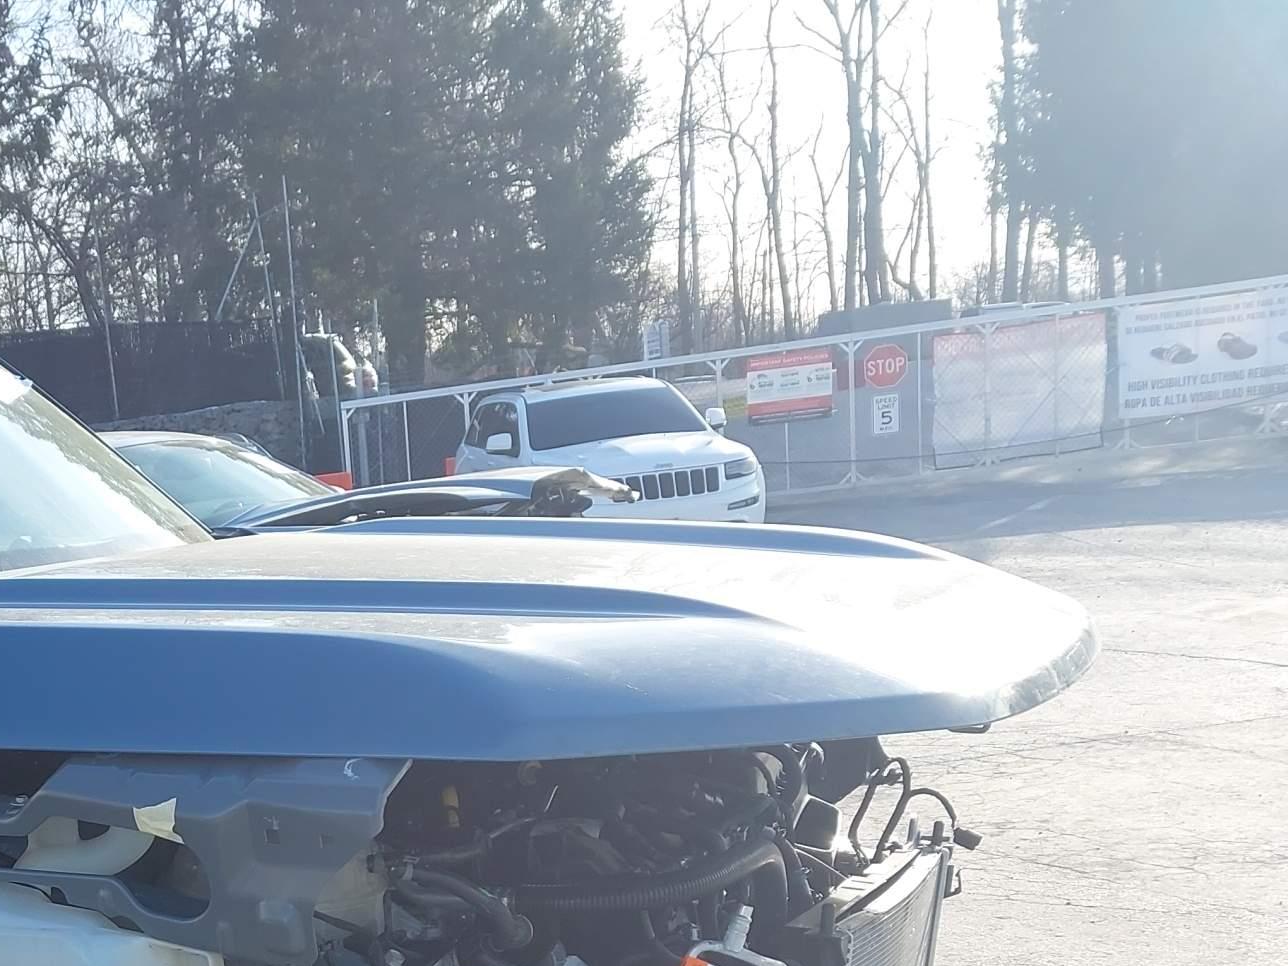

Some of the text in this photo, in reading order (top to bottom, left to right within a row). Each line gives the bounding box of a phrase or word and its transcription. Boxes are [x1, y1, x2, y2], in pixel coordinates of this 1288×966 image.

[867, 356, 905, 376] STOP
[1128, 380, 1148, 392] HIGH
[875, 396, 897, 404] SPEED
[1164, 392, 1187, 406] ALTA
[881, 410, 892, 425] 5
